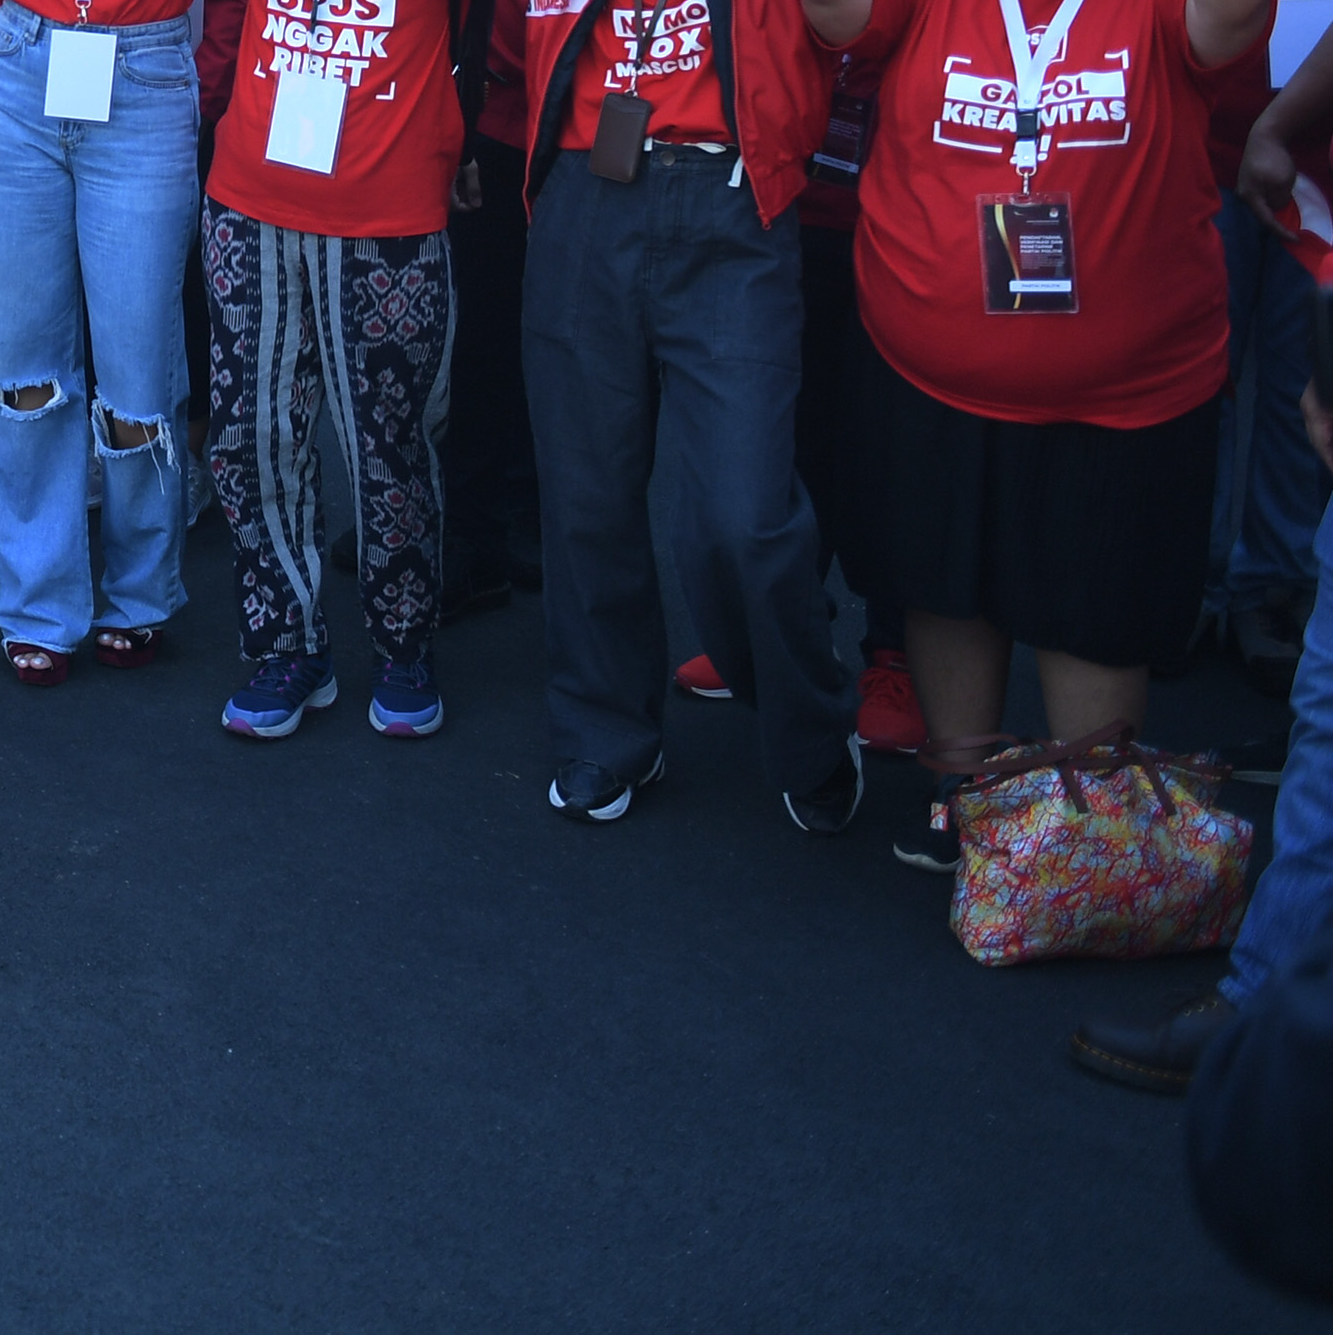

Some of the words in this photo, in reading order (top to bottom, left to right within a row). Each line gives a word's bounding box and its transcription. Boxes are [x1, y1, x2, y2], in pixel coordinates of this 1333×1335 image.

[262, 13, 390, 58] NGGAK
[269, 45, 370, 87] RIBET
[980, 77, 1090, 105] GAOL
[942, 100, 1127, 133] KREAVITAS
